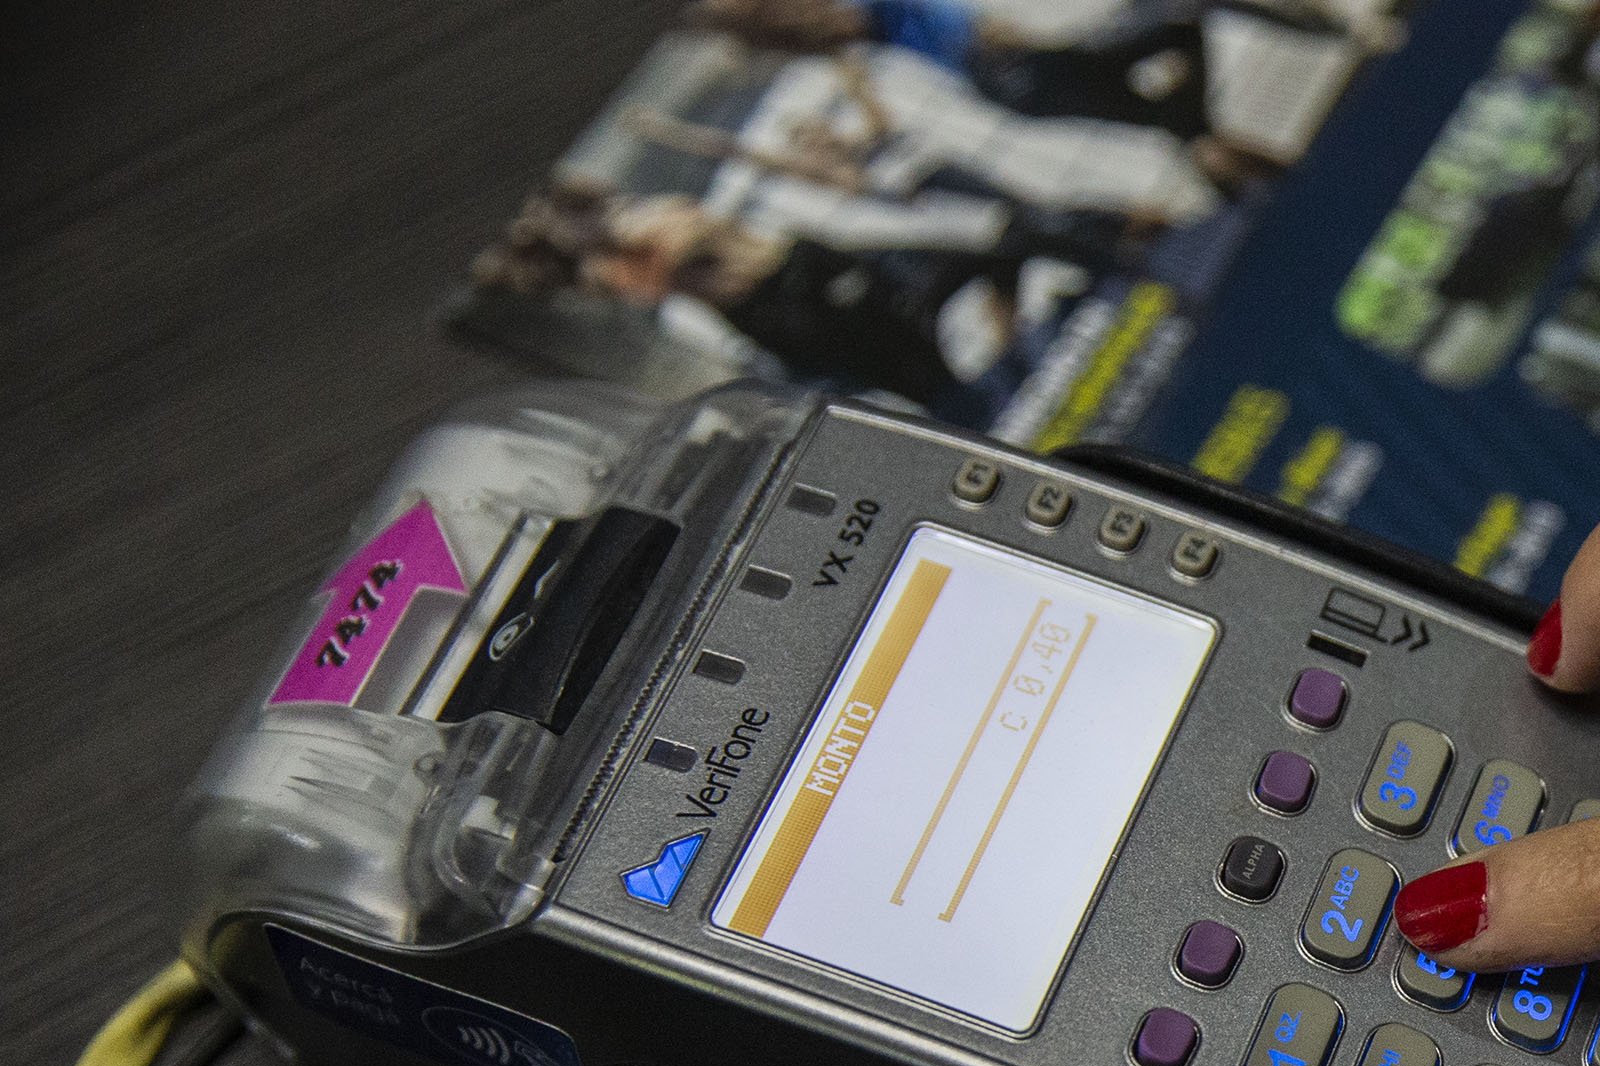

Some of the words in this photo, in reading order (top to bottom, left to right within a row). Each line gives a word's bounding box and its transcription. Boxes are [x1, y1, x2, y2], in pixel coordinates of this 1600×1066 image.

[966, 461, 989, 485] F1
[1036, 487, 1059, 511] F2
[1111, 510, 1134, 535] F3
[811, 549, 854, 586] VX
[838, 499, 880, 547] 520
[1183, 537, 1207, 559] F4
[314, 560, 403, 668] 7474
[675, 707, 771, 818] VeriFone
[804, 701, 876, 796] MONTO
[1242, 844, 1266, 880] ALPHA
